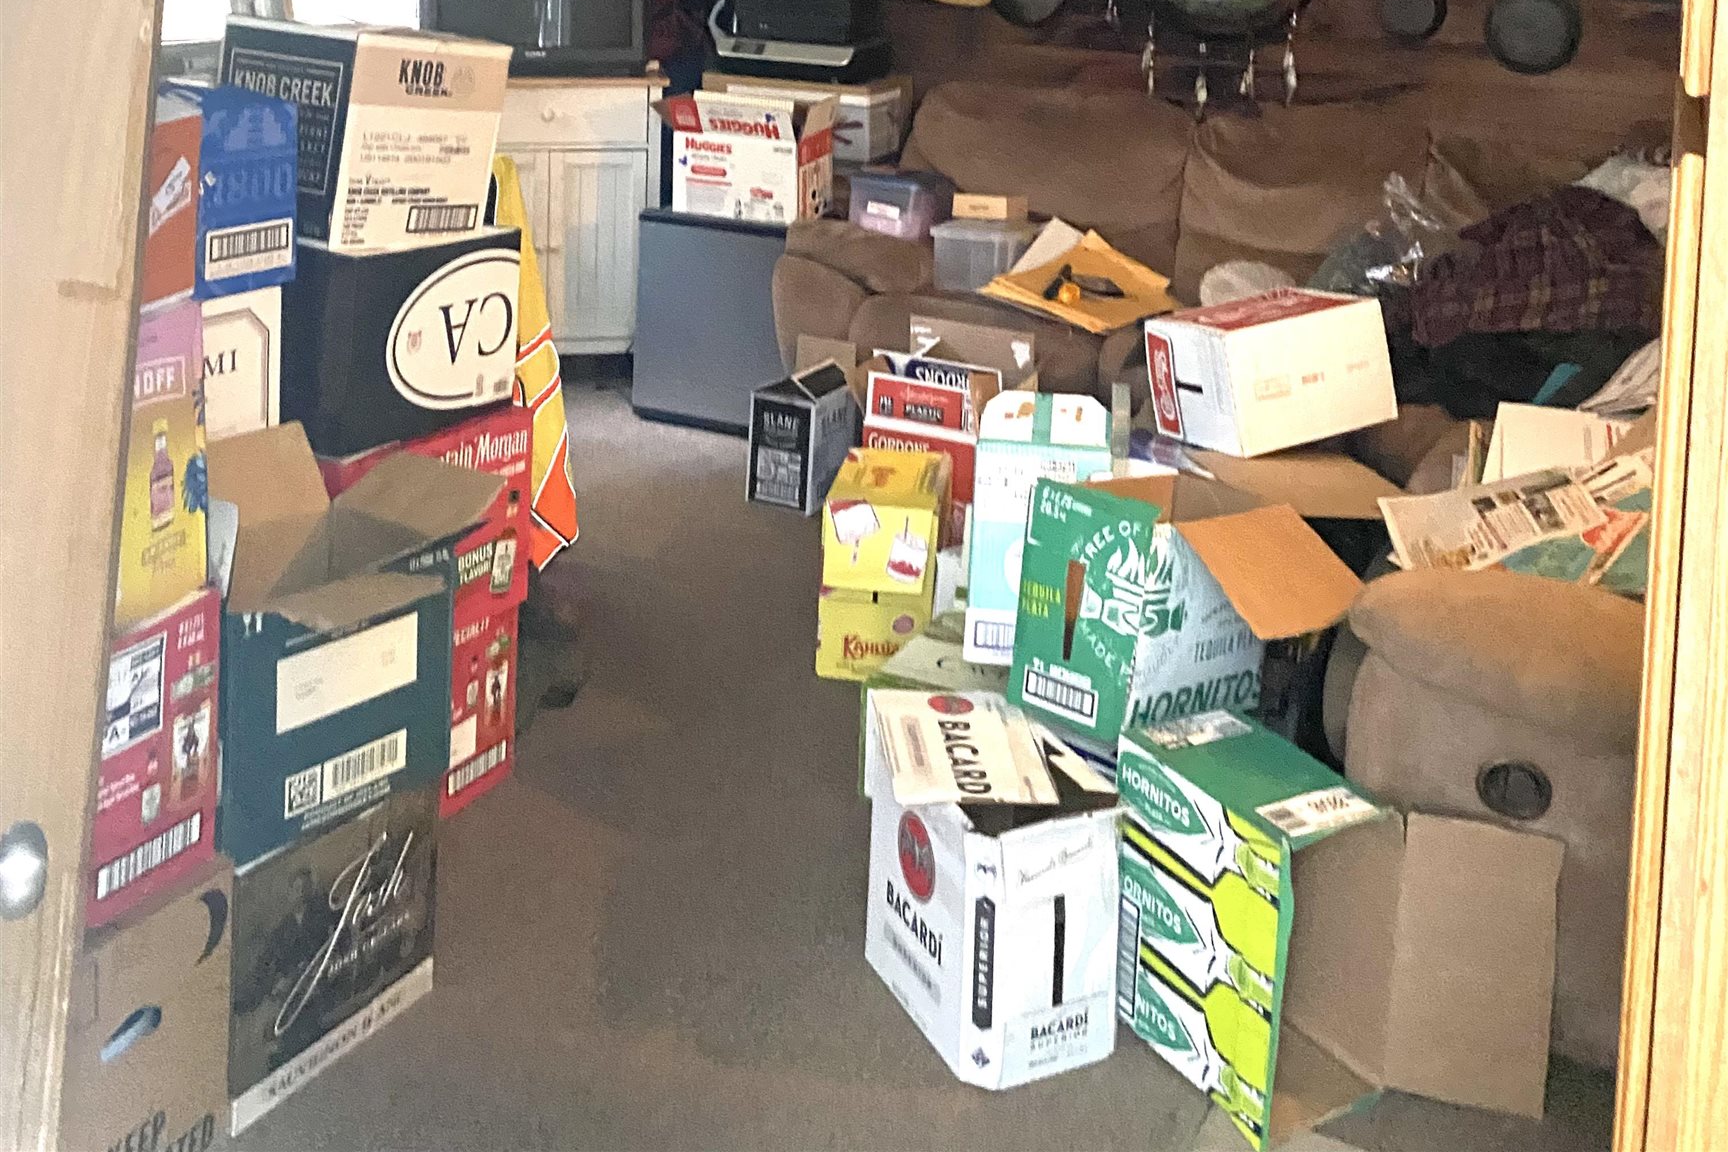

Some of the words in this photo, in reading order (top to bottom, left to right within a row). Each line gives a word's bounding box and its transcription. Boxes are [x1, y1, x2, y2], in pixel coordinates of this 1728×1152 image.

[234, 69, 276, 97] KNOB
[279, 76, 333, 107] CREEK
[399, 59, 444, 86] KNOB
[685, 136, 732, 154] HUGGIES
[709, 117, 780, 140] HUGGIES
[438, 292, 512, 365] CA
[440, 440, 474, 470] tain
[474, 430, 528, 469] Morgan
[458, 542, 493, 573] BONUS
[1022, 596, 1049, 619] PLATA
[1023, 580, 1061, 605] TEQUILA
[1130, 669, 1261, 729] HORNITOS
[938, 719, 992, 794] BACARD
[1122, 763, 1190, 828] HORNITOS
[1124, 875, 1182, 935] ORNITOS
[1136, 994, 1177, 1042] NITOS
